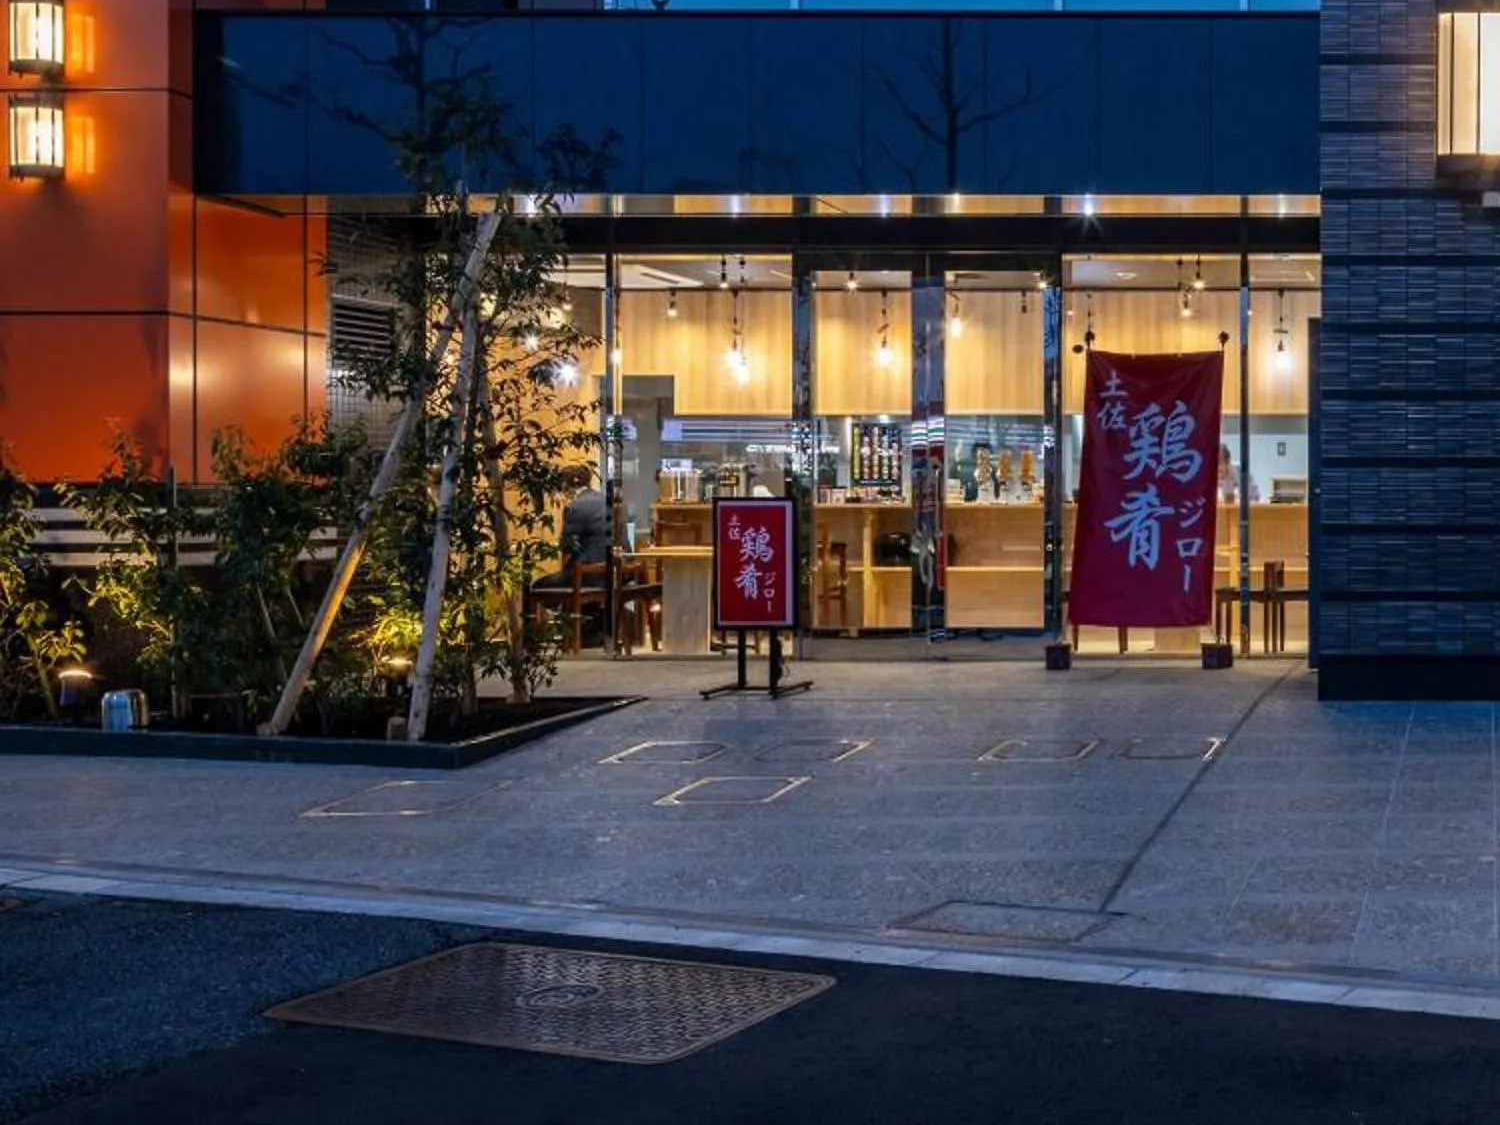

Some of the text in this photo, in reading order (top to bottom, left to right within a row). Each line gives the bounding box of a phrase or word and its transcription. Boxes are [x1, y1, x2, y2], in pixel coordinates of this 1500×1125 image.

[1096, 371, 1129, 431] 土佐
[1175, 496, 1206, 594] ジロー
